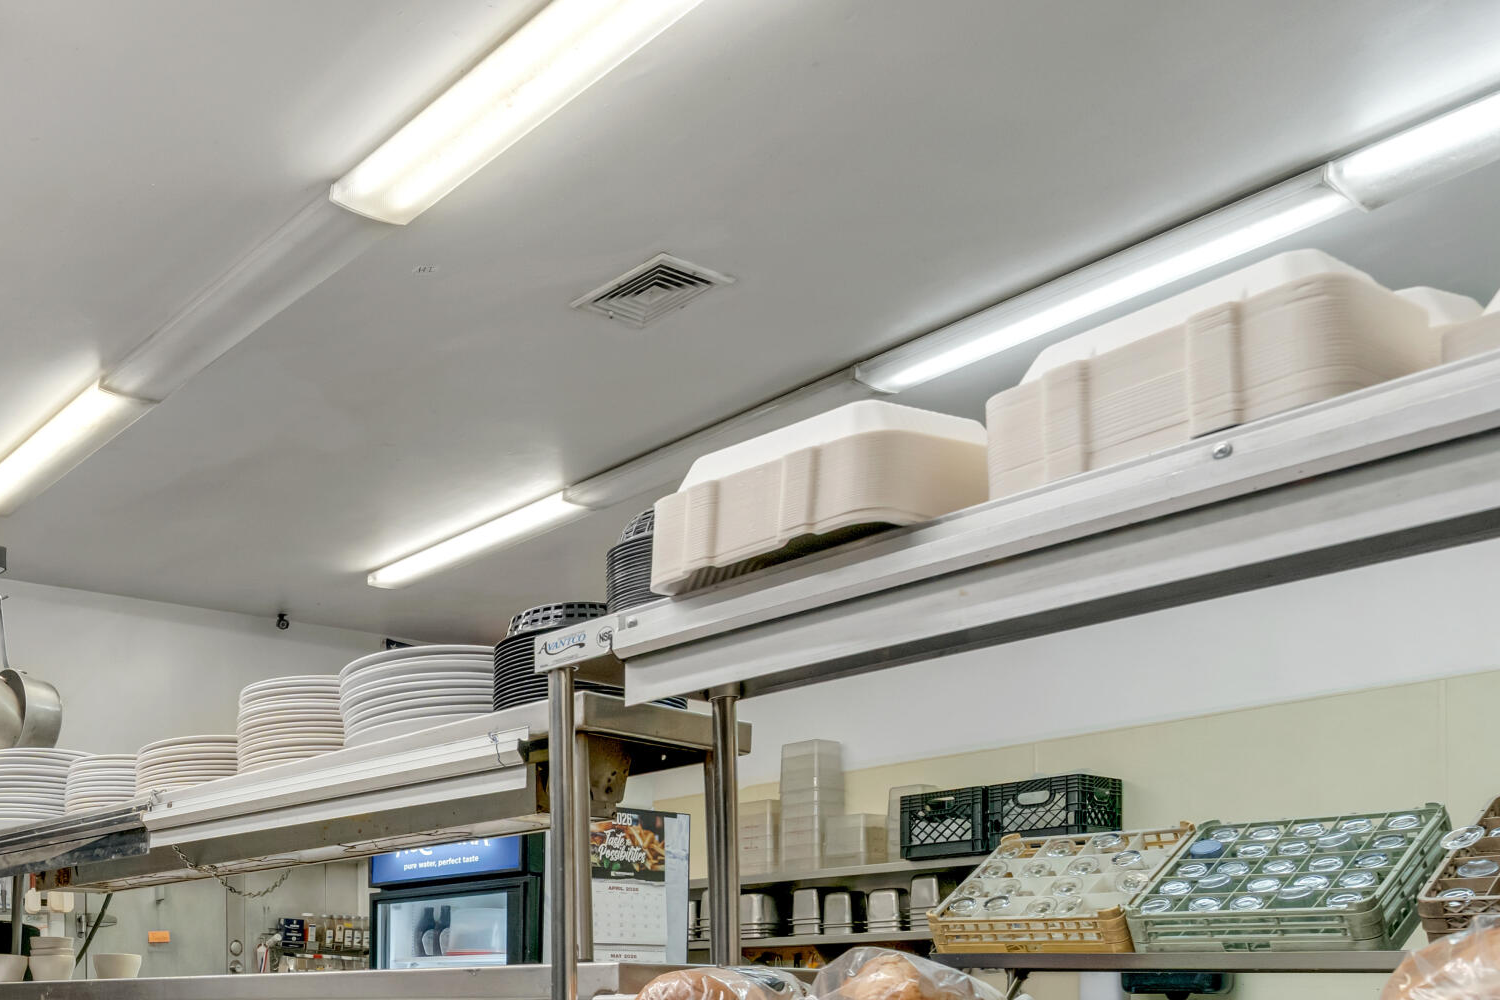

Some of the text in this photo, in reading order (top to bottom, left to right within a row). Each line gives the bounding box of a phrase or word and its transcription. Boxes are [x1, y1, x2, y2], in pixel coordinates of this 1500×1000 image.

[612, 812, 632, 825] 026
[604, 829, 626, 848] Taste
[438, 857, 462, 867] perfect
[462, 855, 479, 863] taste
[598, 843, 647, 863] Possibilities
